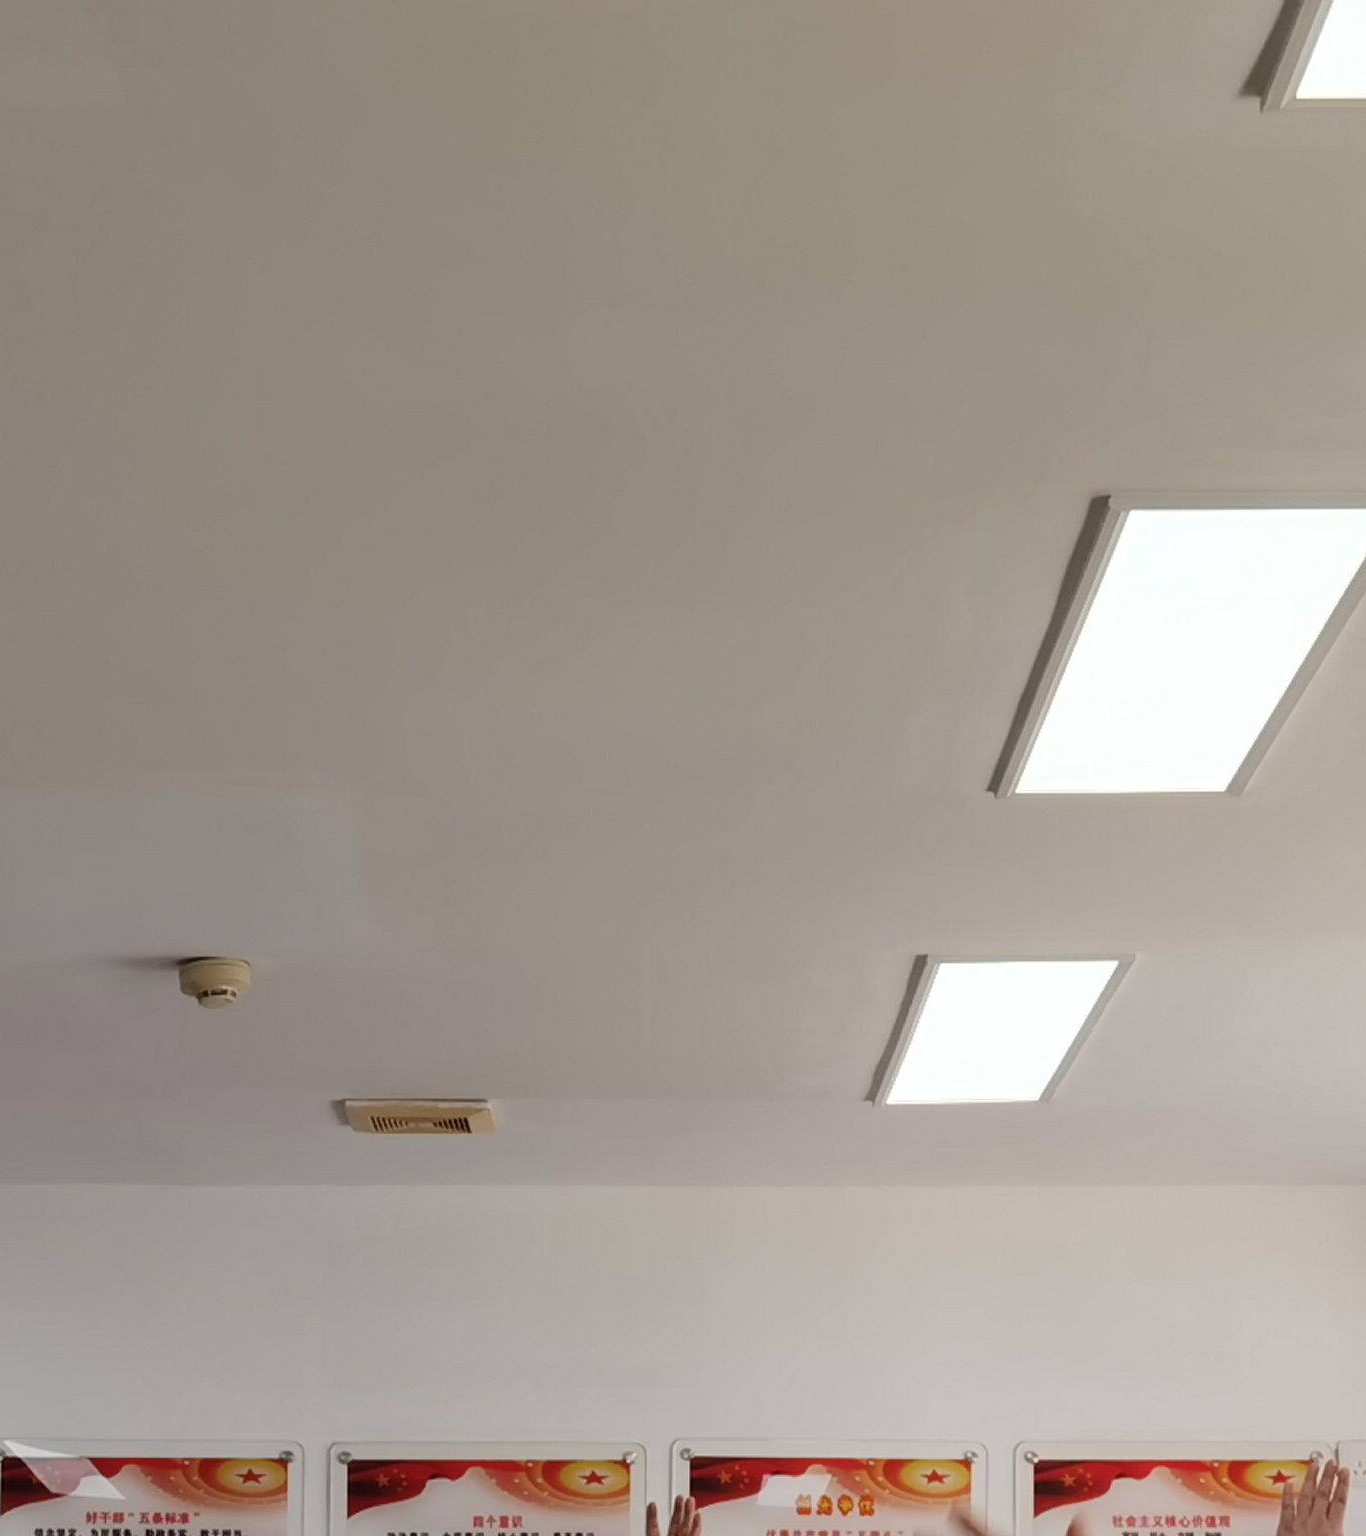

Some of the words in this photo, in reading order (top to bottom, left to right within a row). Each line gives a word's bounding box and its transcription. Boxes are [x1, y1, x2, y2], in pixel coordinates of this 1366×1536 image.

[473, 1515, 523, 1528] 四个意识
[1113, 1515, 1231, 1528] 社会主义核心价值观
